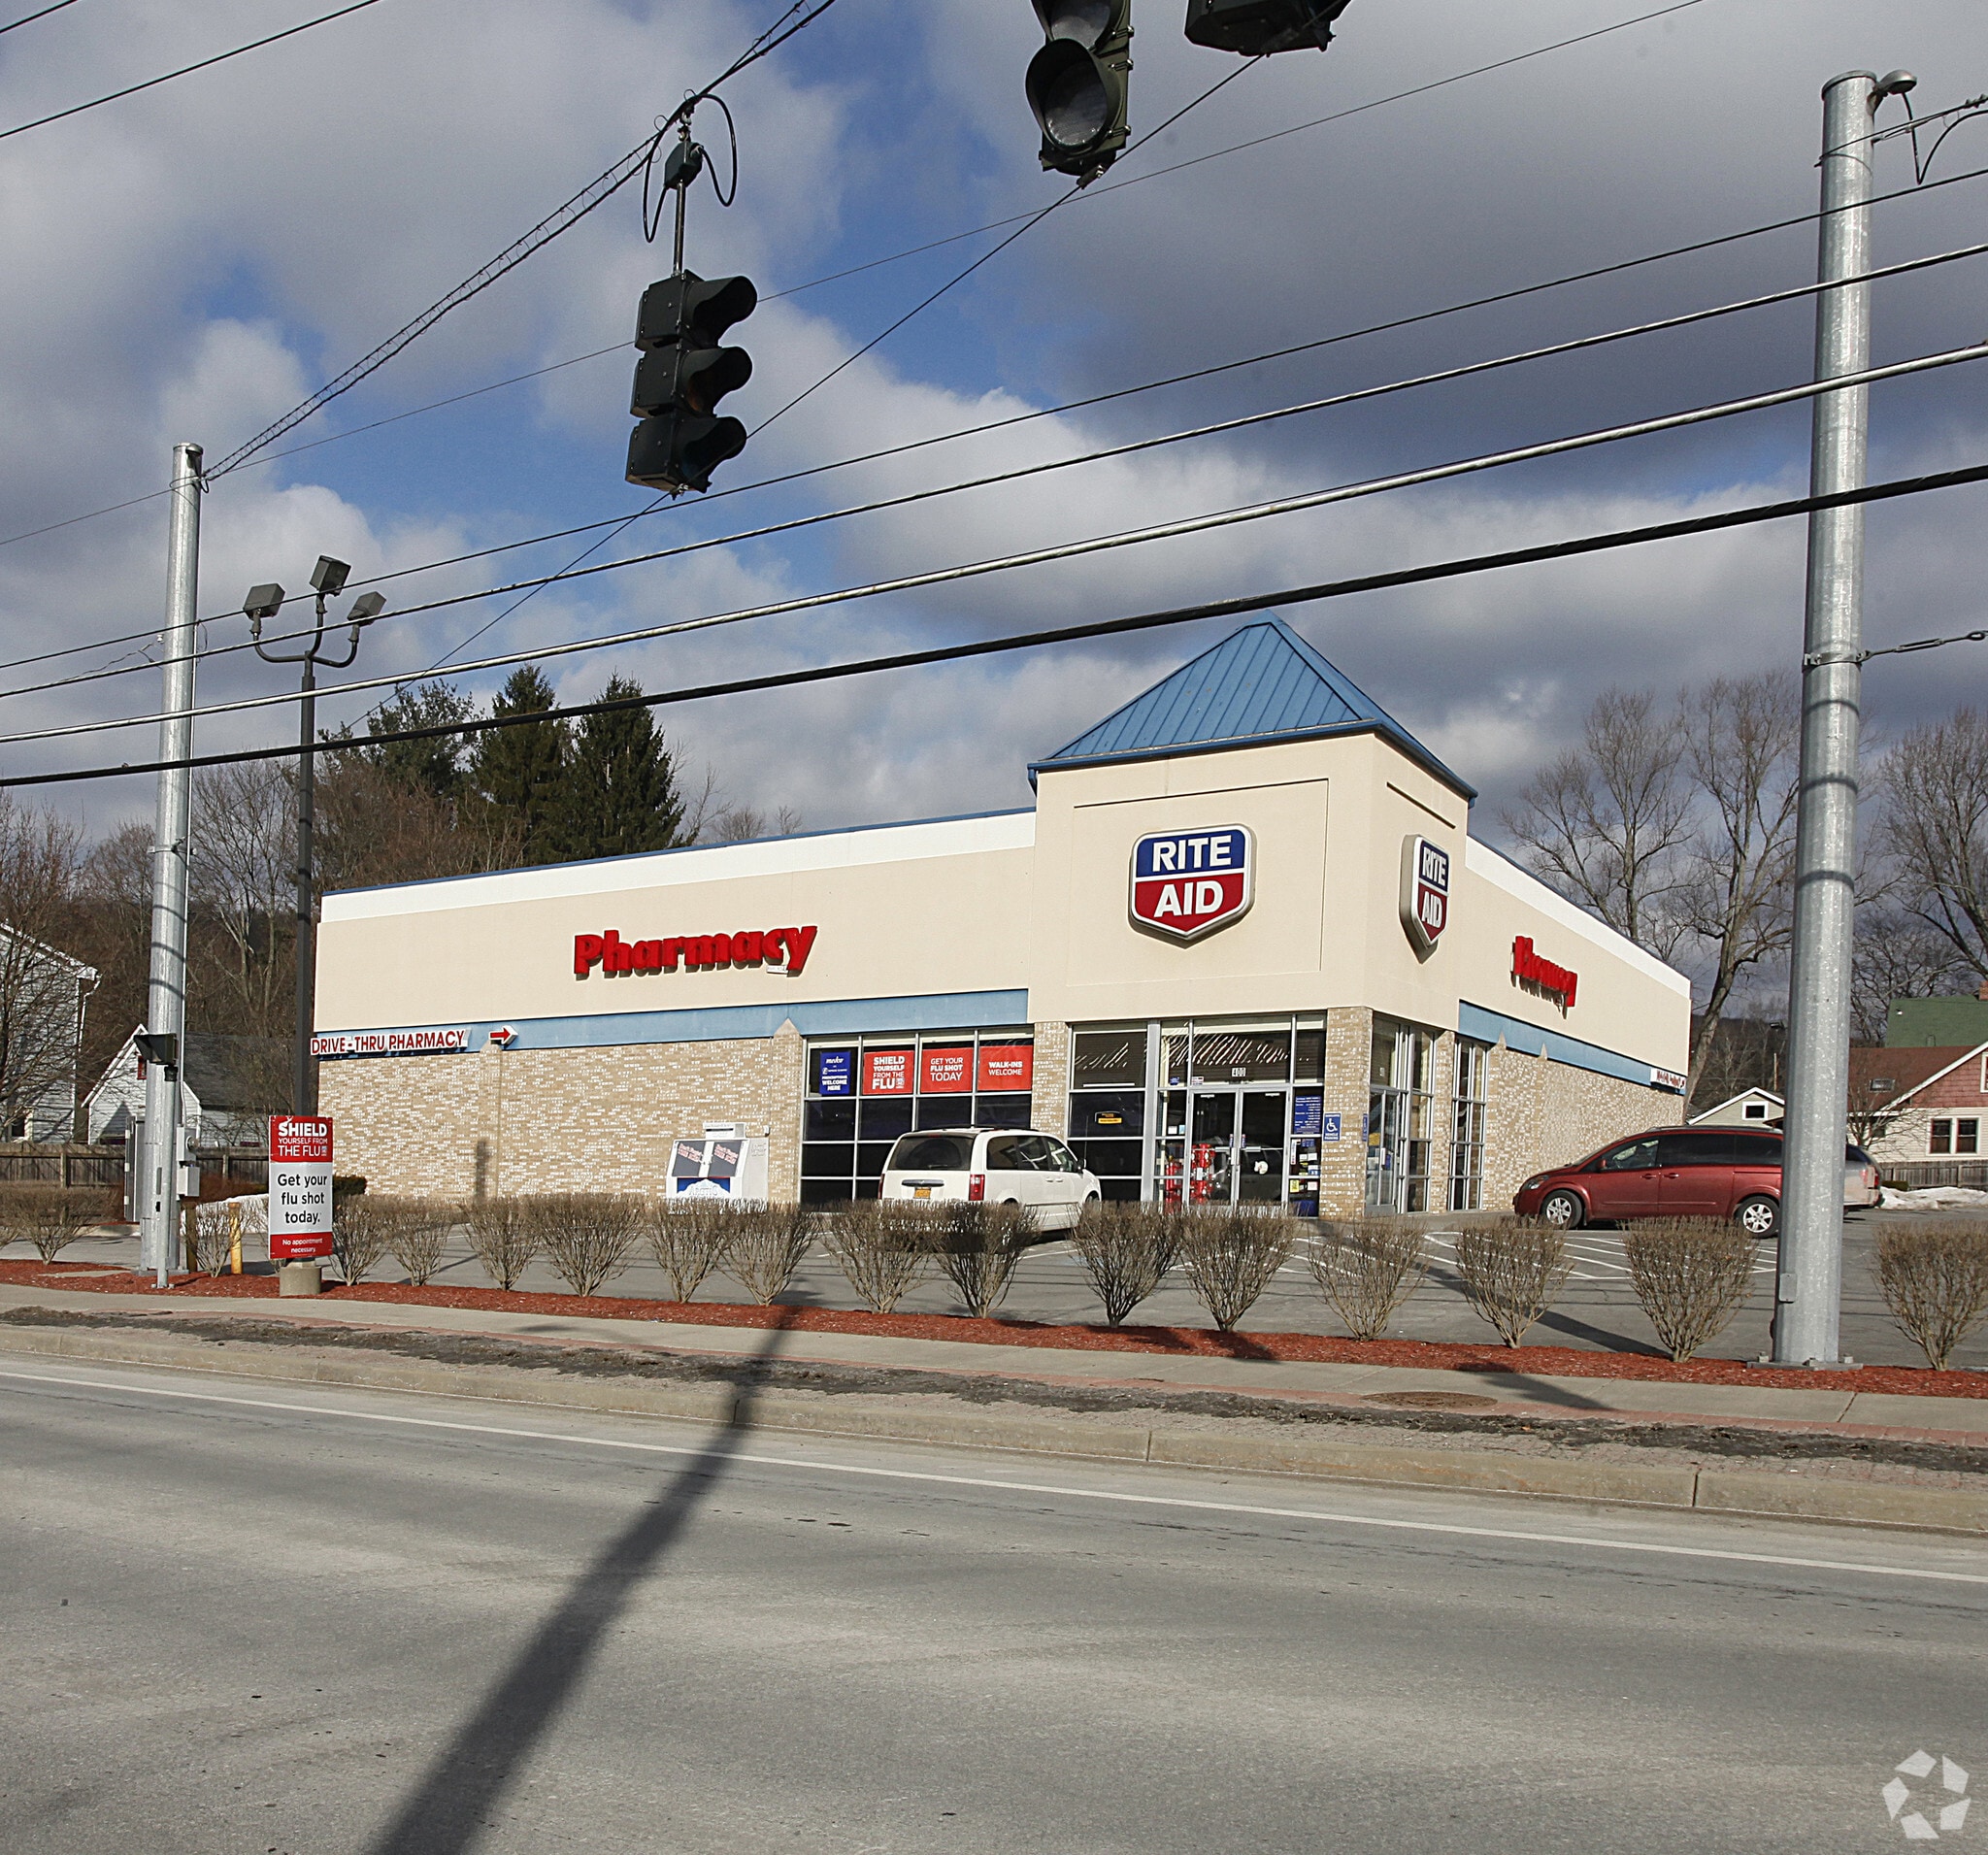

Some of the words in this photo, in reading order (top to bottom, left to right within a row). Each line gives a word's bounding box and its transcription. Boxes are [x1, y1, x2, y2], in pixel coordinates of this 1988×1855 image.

[1152, 835, 1232, 872] RITE
[1422, 846, 1446, 886] RITE
[1153, 880, 1224, 917] AID
[1421, 891, 1442, 928] AID
[574, 925, 817, 977] Pharmacy
[388, 1030, 465, 1050] PHARMACY
[874, 1055, 905, 1065] SHIELD
[930, 1072, 963, 1082] TODAY
[1233, 1068, 1245, 1077] 400
[872, 1078, 895, 1090] FLU
[279, 1123, 327, 1137] SHIELD
[278, 1145, 300, 1156] THE
[302, 1144, 321, 1156] FLU
[278, 1174, 301, 1186] Get
[304, 1176, 327, 1188] your
[282, 1192, 298, 1205] flu
[302, 1191, 324, 1205] shot
[285, 1210, 320, 1225] today.
